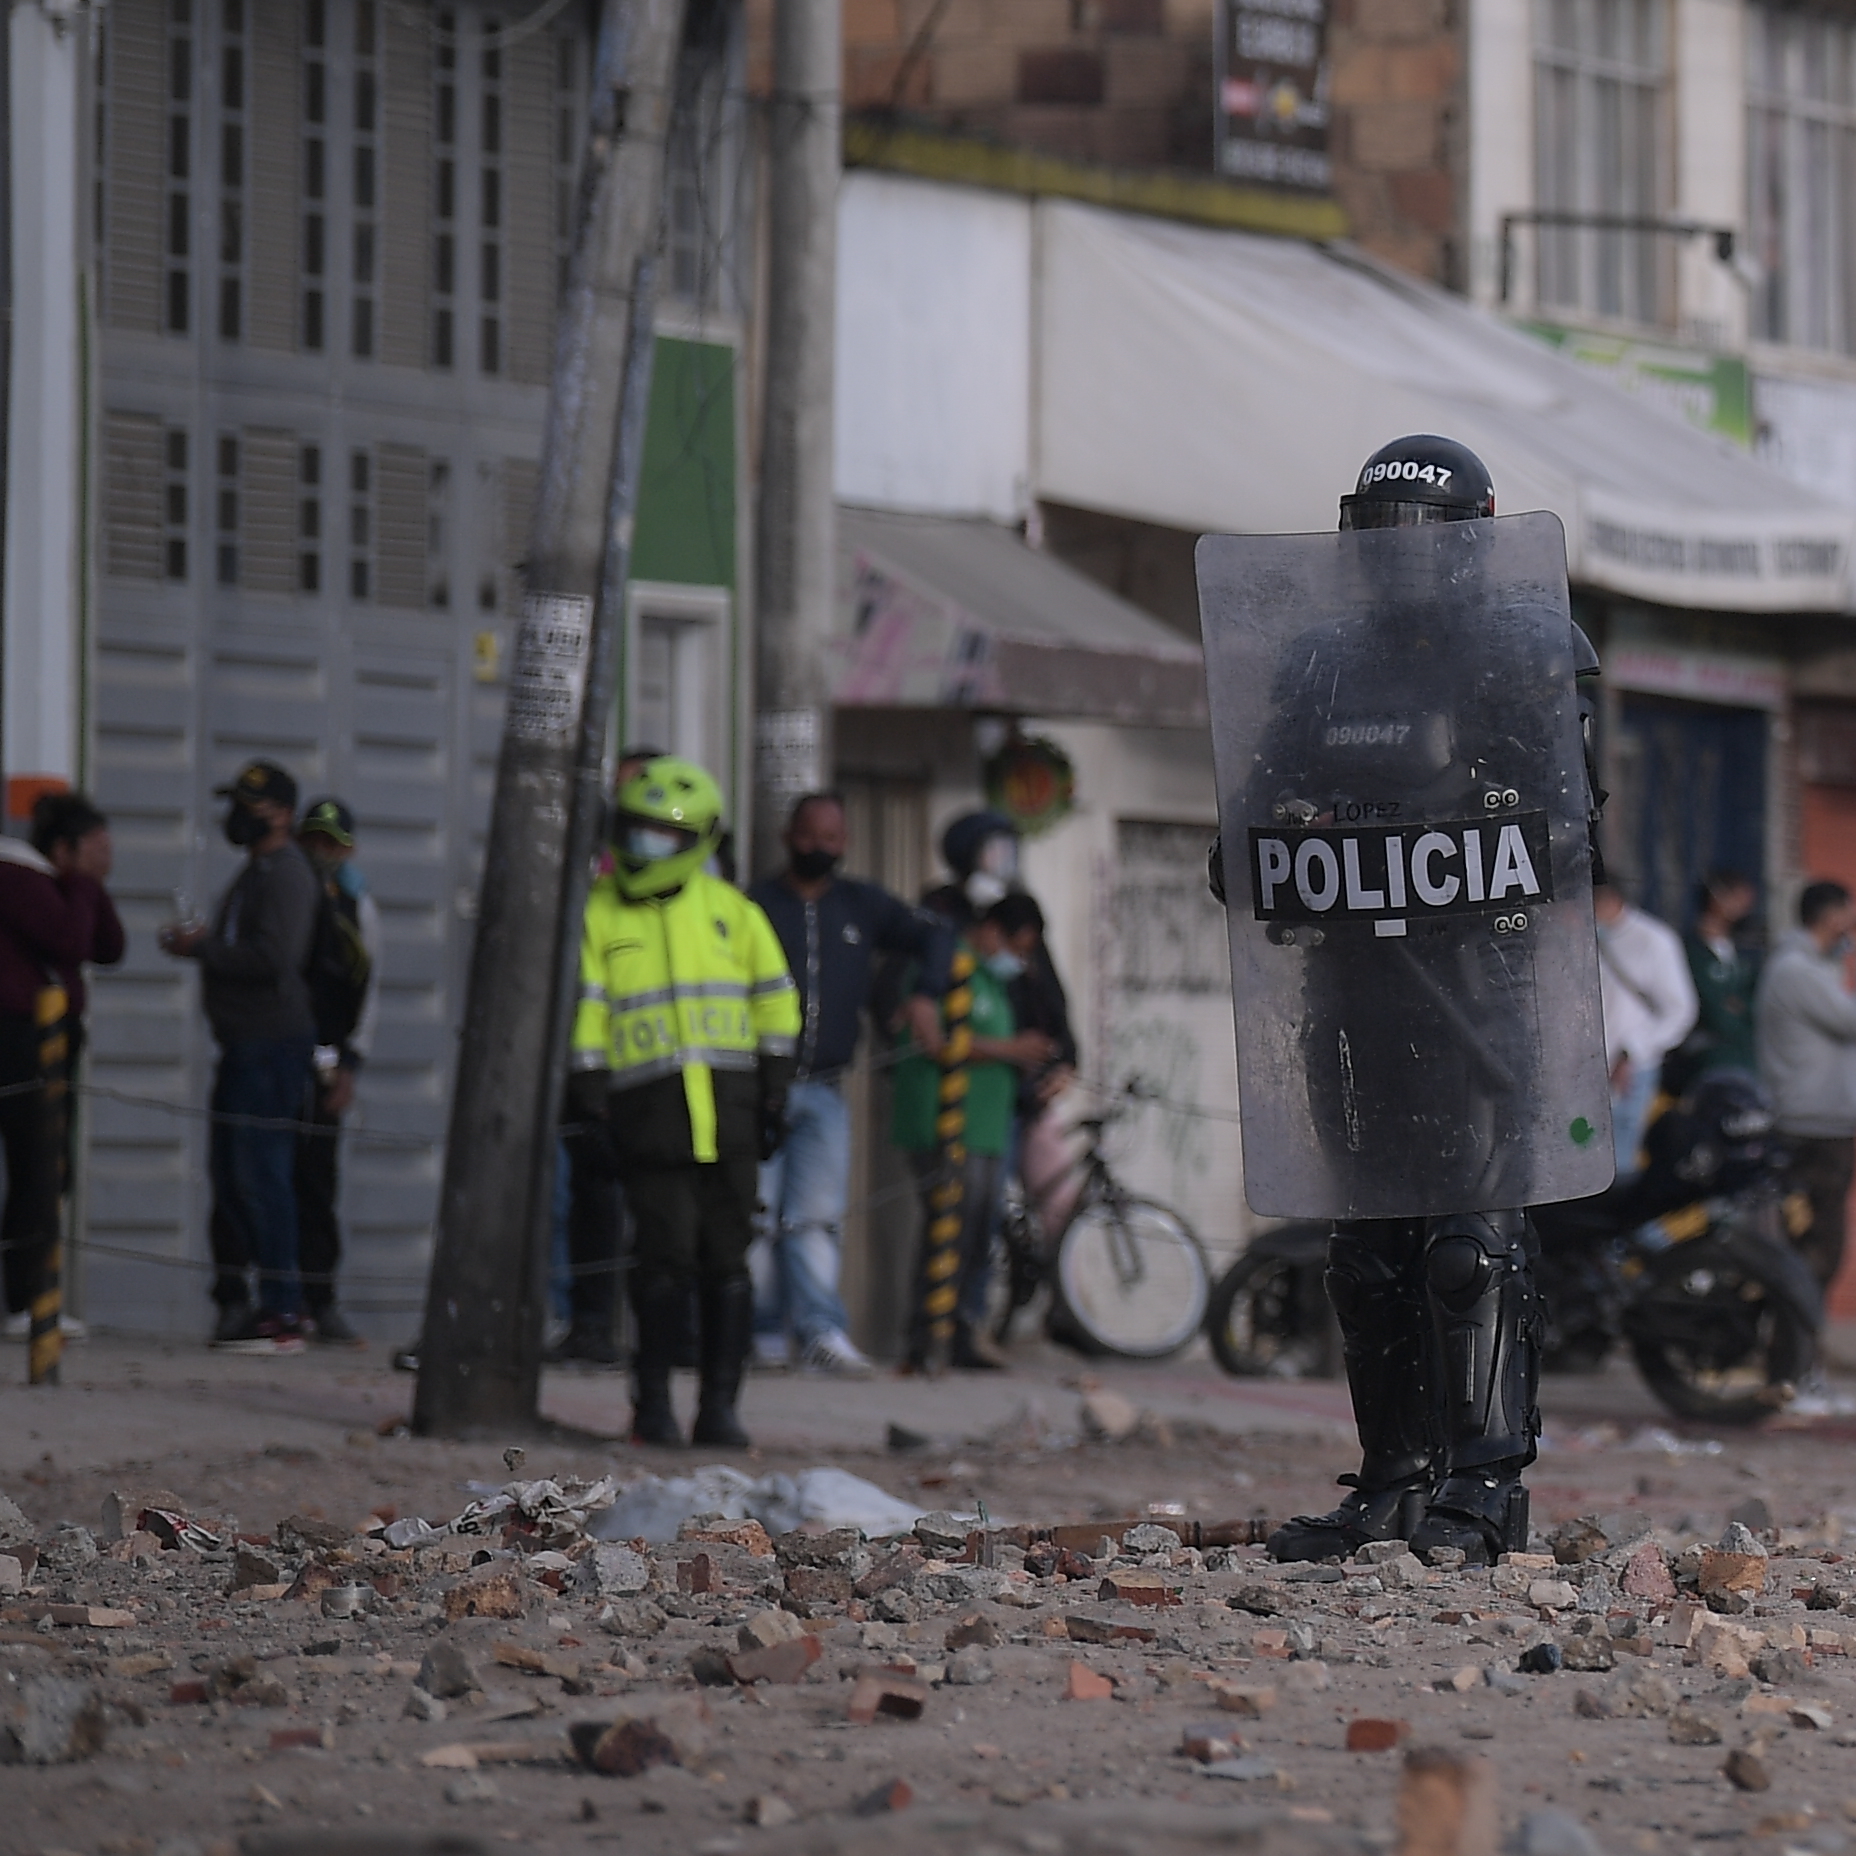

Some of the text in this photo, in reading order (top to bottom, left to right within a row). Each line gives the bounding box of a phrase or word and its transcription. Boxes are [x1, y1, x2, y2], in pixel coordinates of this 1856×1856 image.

[1362, 460, 1453, 487] 090047
[1332, 801, 1403, 824] LOPEZ
[1256, 822, 1542, 913] POLICIA
